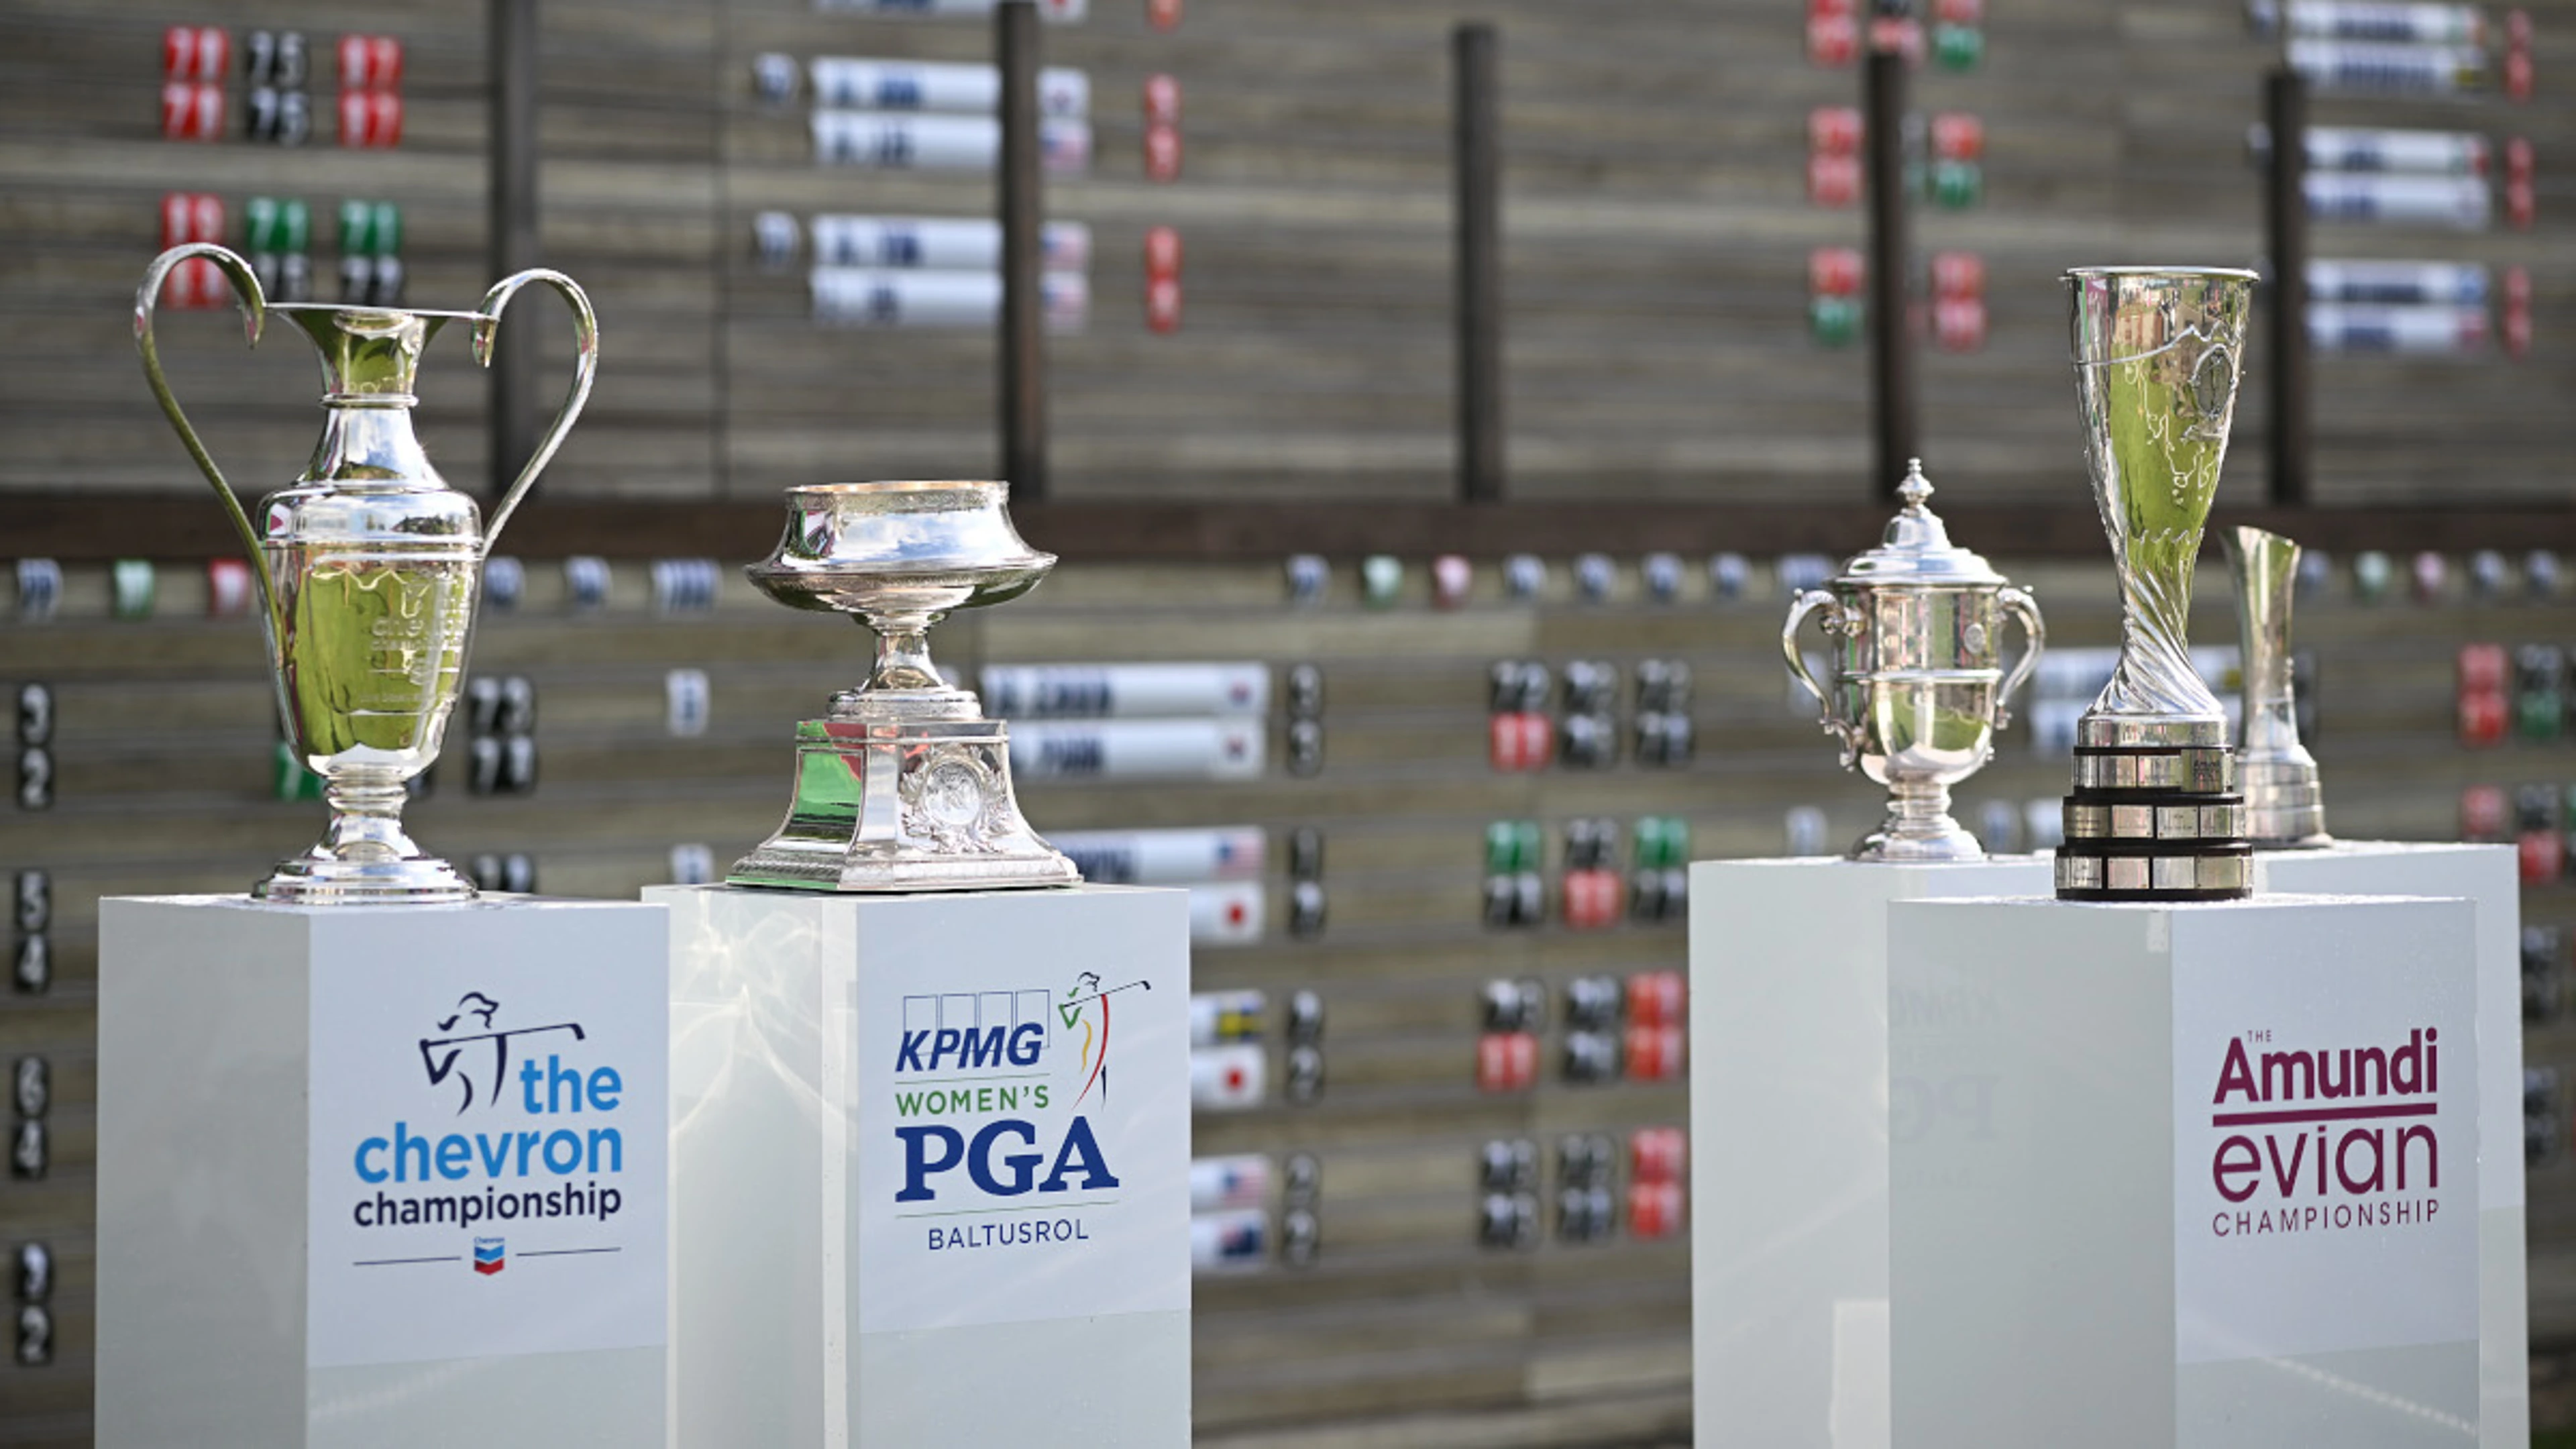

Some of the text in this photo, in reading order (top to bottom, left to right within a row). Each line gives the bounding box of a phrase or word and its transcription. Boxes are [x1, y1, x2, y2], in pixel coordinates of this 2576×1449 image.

[896, 1022, 1044, 1072] KPMG
[2247, 1030, 2271, 1042] THE
[520, 1055, 622, 1114] the
[2213, 1027, 2437, 1104] Amundi
[896, 1085, 1049, 1116] WOMEN'S
[354, 1122, 622, 1183] chevron
[895, 1116, 1119, 1202] PGA
[2213, 1125, 2438, 1202] evian
[354, 1181, 622, 1228] championship
[2213, 1199, 2438, 1236] CHAMPIONSHIP
[928, 1219, 1089, 1250] BALTUSROL
